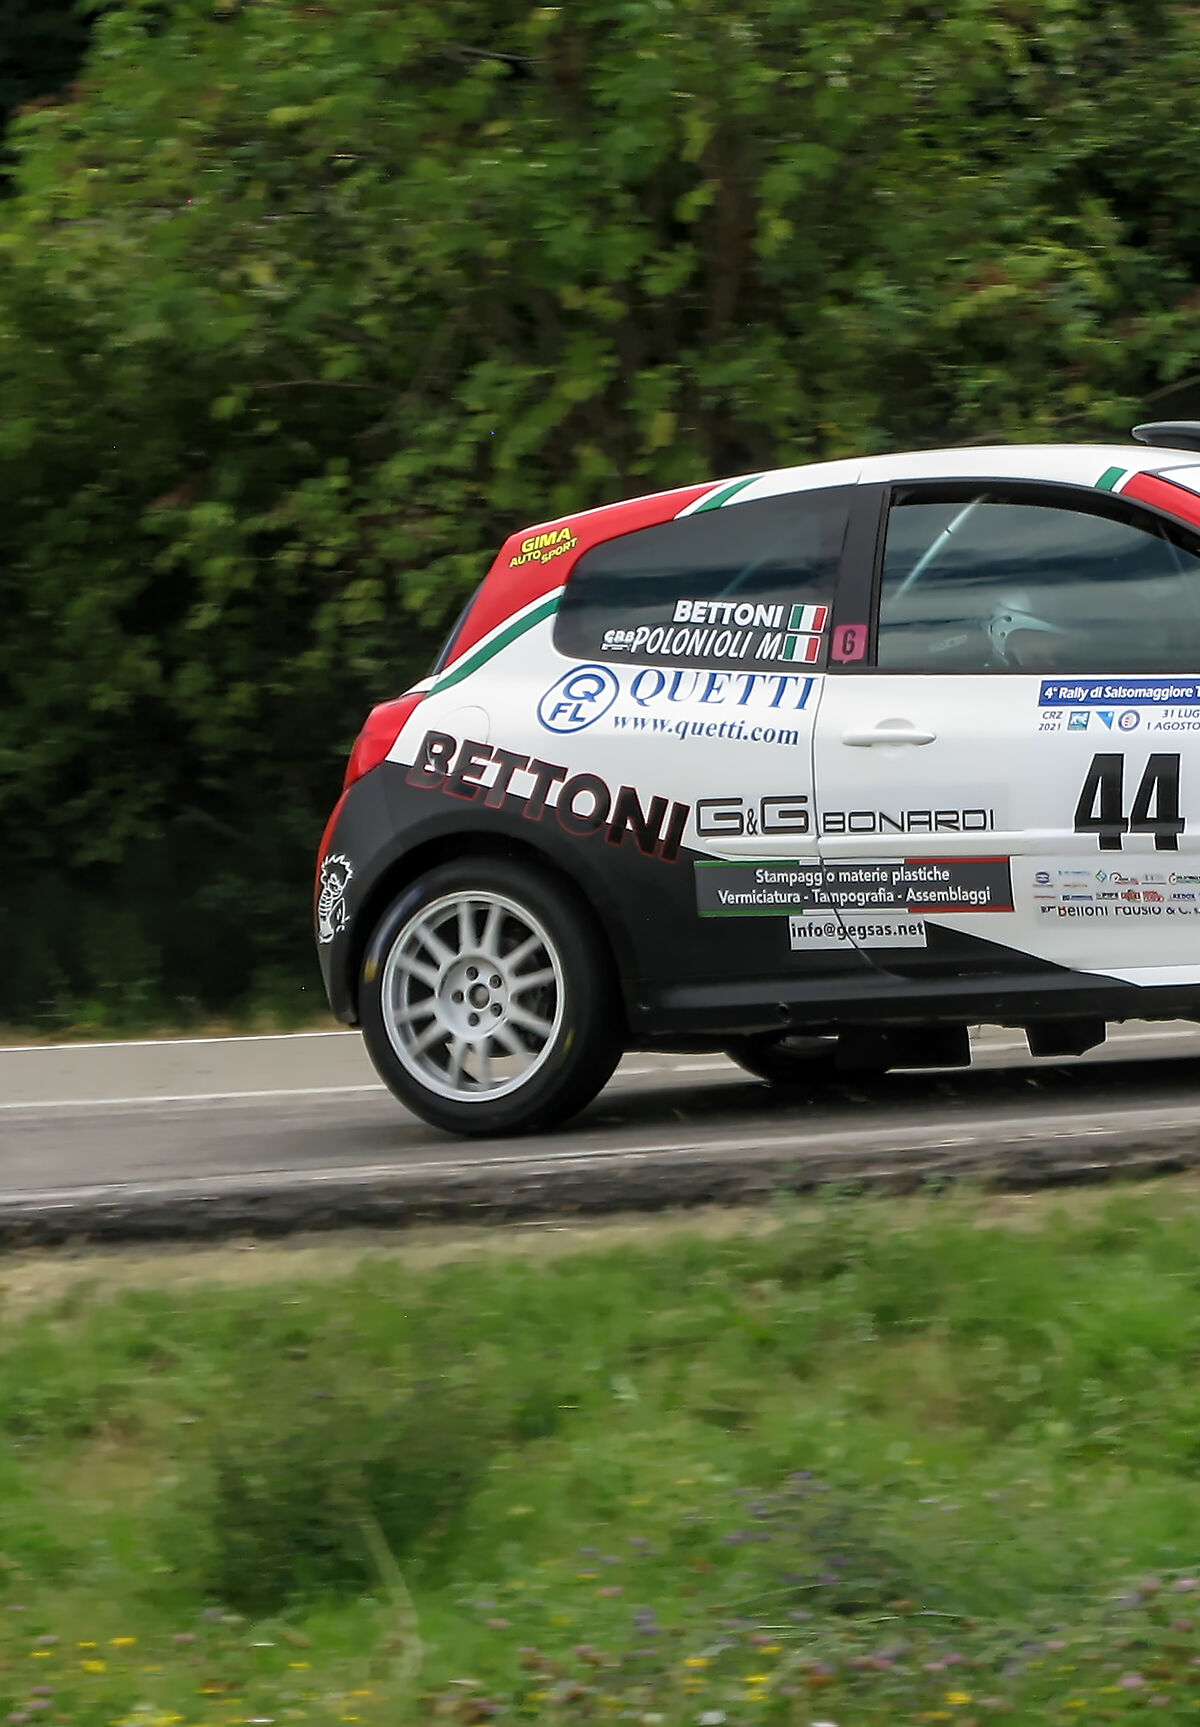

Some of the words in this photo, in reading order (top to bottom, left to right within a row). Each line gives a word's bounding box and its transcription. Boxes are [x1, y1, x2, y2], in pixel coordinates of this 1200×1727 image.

[508, 550, 542, 568] AUTO
[540, 536, 578, 565] SPORT
[520, 527, 572, 554] GIMA
[673, 599, 785, 628] BETTONI
[630, 626, 752, 659] POLONIOLI
[629, 668, 818, 710] QUETTI
[1058, 686, 1089, 702] Rally
[1090, 686, 1102, 698] di
[1103, 685, 1194, 702] Salsomaggiore
[547, 702, 588, 723] FL
[1042, 711, 1063, 720] CRZ
[1162, 709, 1176, 719] 31
[612, 714, 799, 746] www.quetti.com
[1038, 723, 1062, 731] 2021
[404, 729, 691, 864] BETTONI
[1073, 752, 1186, 851] 44
[695, 796, 809, 837] G&G
[822, 808, 996, 833] BONARDI
[755, 868, 835, 886] Stampaggo
[838, 867, 888, 882] materie
[891, 866, 950, 886] plastiche
[905, 886, 991, 905] Assemblaggi
